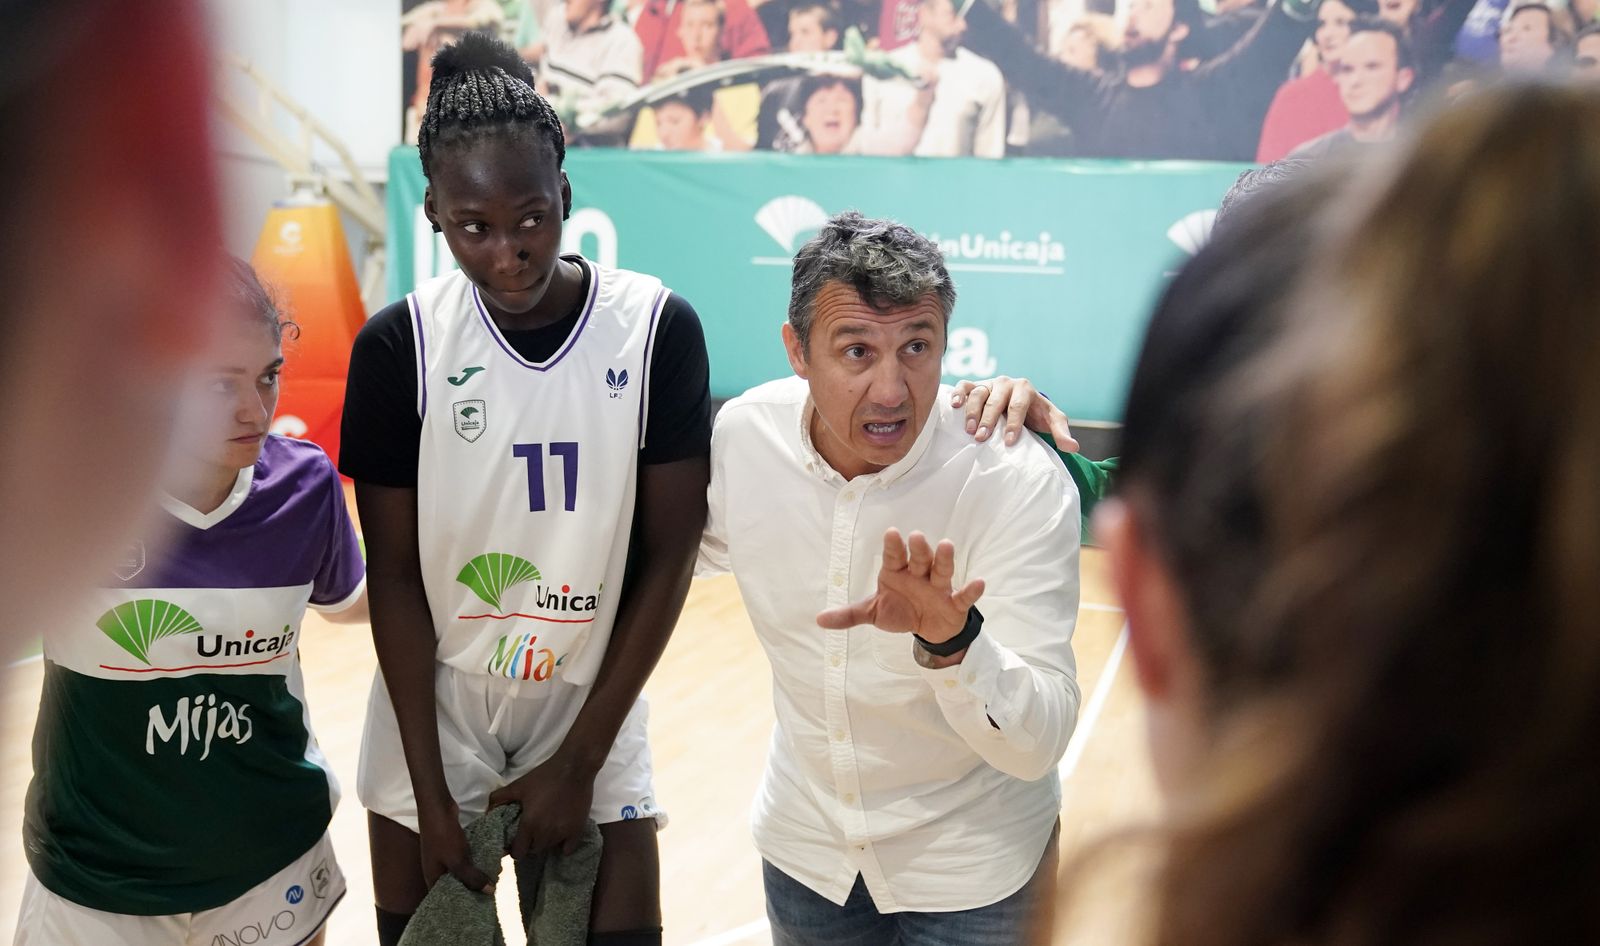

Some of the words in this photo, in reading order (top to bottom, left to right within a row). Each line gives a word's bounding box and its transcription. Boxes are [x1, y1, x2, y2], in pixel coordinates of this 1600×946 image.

[513, 442, 579, 512] 11
[197, 624, 295, 658] Unicaja
[145, 693, 253, 762] Mijas
